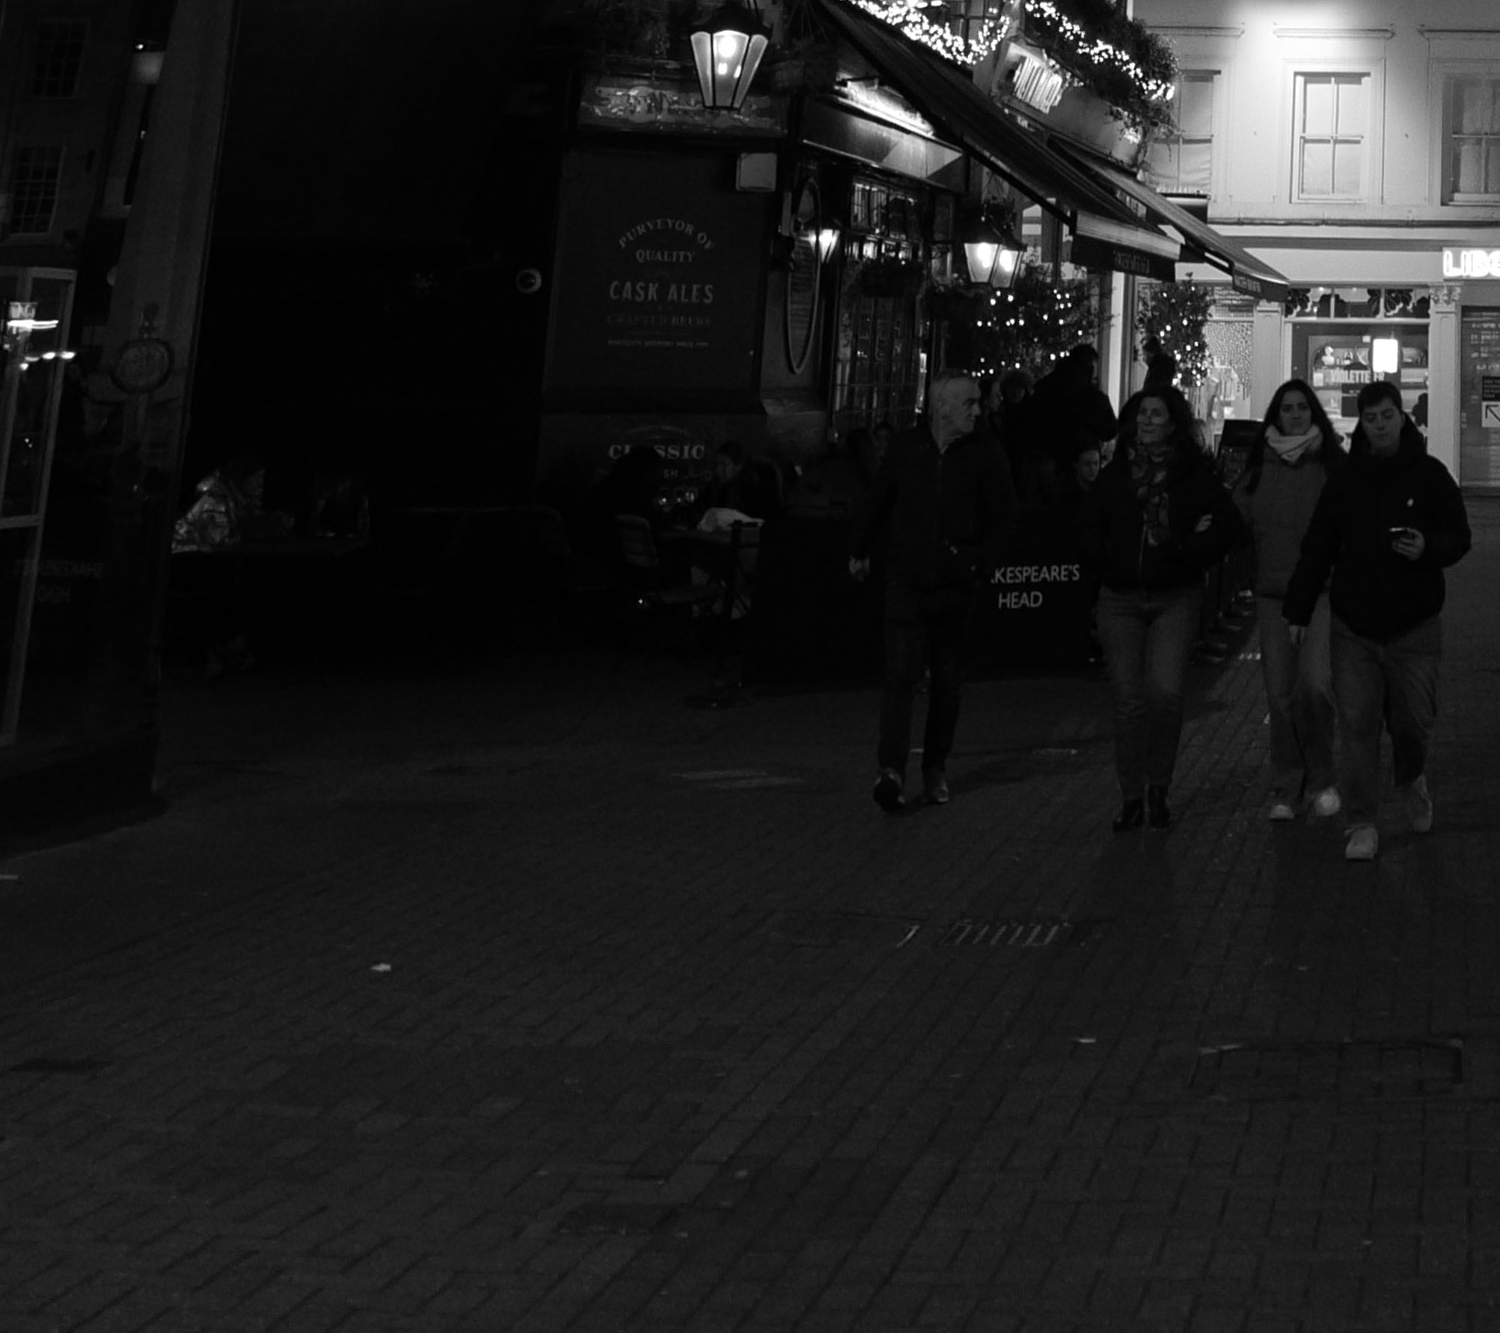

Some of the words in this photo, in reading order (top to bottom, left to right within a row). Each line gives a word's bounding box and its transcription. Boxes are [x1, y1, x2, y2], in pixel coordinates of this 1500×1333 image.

[618, 218, 695, 249] PURVEYOR
[696, 231, 715, 250] OF
[635, 248, 695, 264] QUALITY
[609, 280, 660, 302] CASK
[667, 283, 714, 305] ALES
[990, 563, 1081, 585] KESPEARE'S
[997, 590, 1044, 610] HEAD
